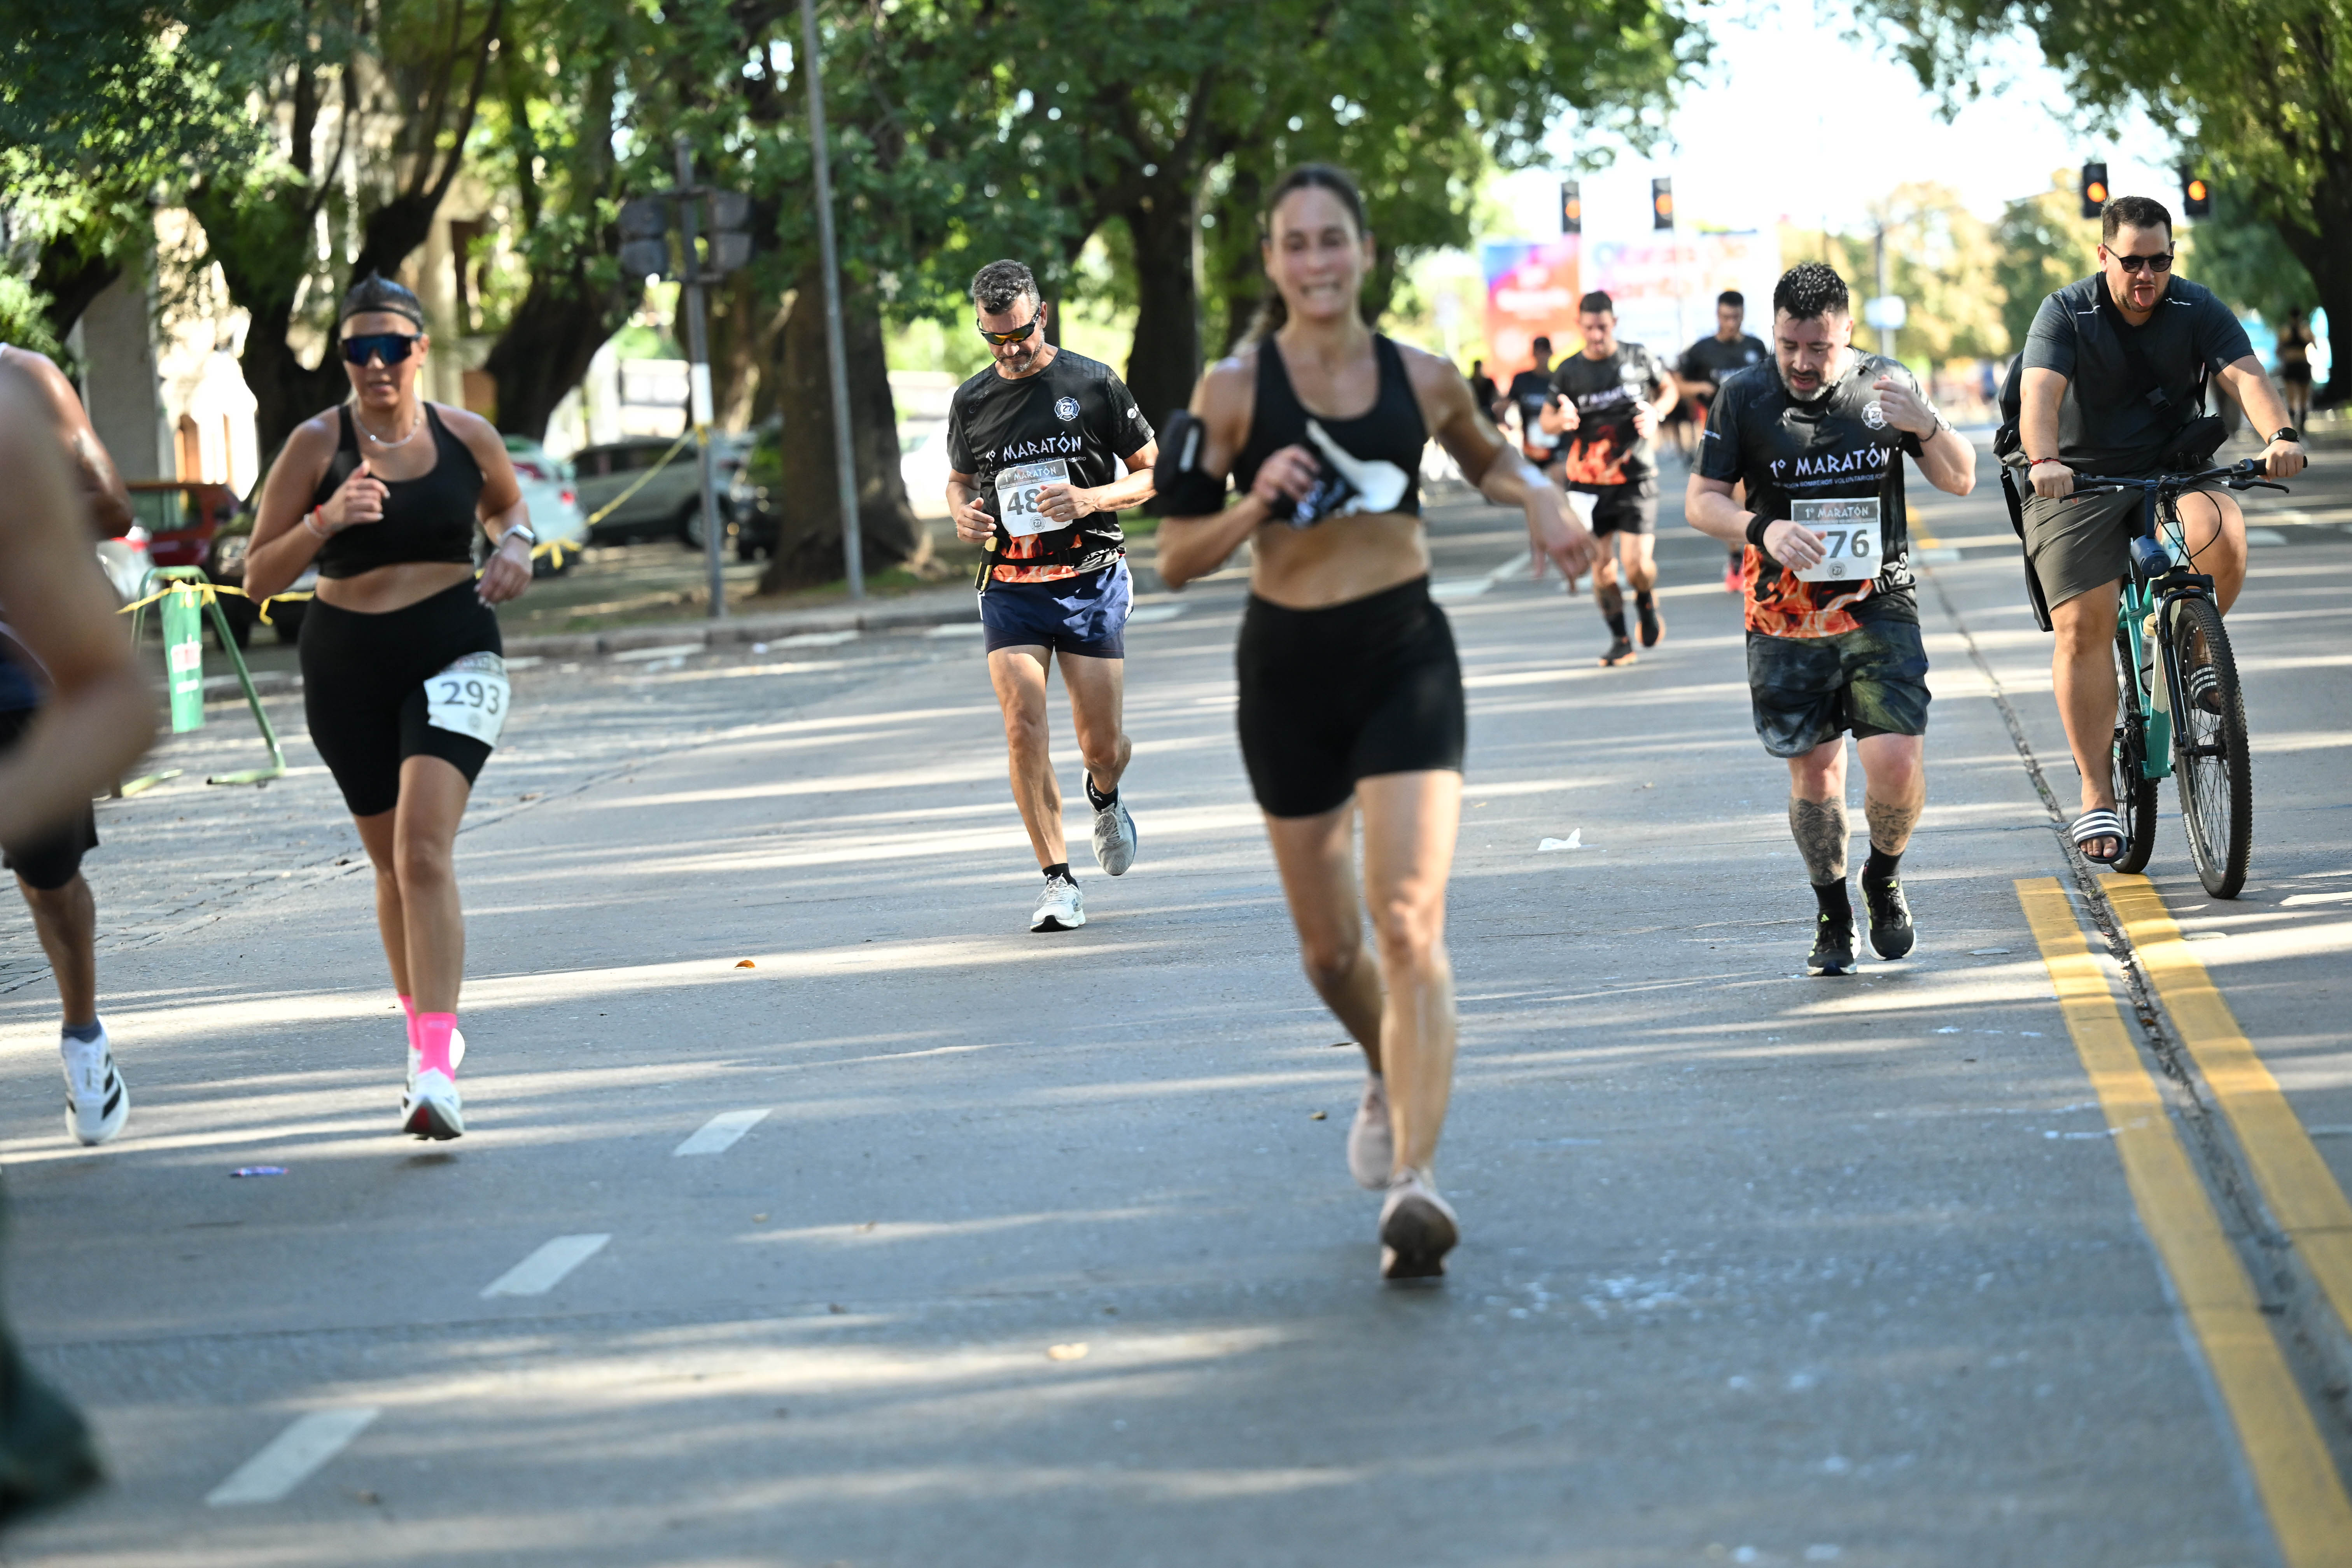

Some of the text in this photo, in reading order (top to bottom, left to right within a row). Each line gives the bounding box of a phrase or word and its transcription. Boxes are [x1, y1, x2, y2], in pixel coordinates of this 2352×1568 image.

[1003, 431, 1081, 462] MARATÓN
[1795, 442, 1890, 476] MARATÓN
[1014, 466, 1057, 481] MARATÓN
[1007, 488, 1041, 515] 48
[1818, 504, 1869, 518] MARATÓN
[1827, 529, 1869, 558] 76
[440, 680, 500, 715] 293
